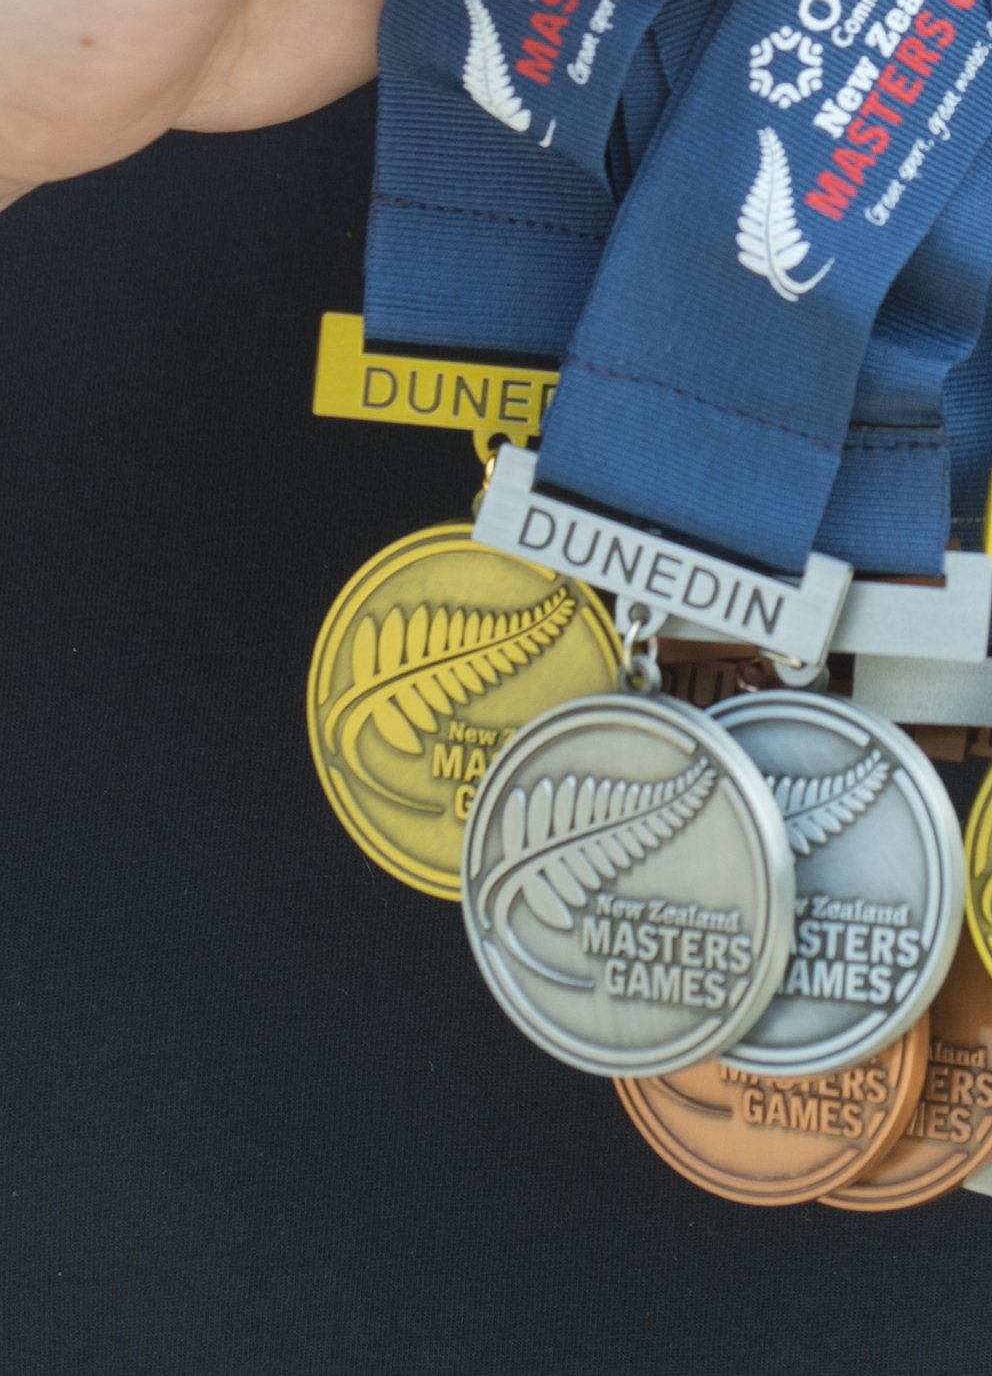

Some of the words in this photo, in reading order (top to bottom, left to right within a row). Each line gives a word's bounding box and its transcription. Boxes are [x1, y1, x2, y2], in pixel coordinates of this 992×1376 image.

[803, 11, 956, 221] MASTERS
[812, 55, 879, 140] New
[362, 366, 558, 423] DUNE
[517, 506, 785, 636] DUNEDIN
[448, 721, 498, 746] New
[597, 892, 646, 920] New
[648, 899, 742, 933] Zealand
[811, 895, 911, 926] Zealand
[582, 914, 752, 974] MASTERS
[789, 918, 920, 968] STERS
[605, 958, 727, 1009] GAMES
[779, 958, 891, 1004] AMES
[742, 1087, 863, 1139] GAMES
